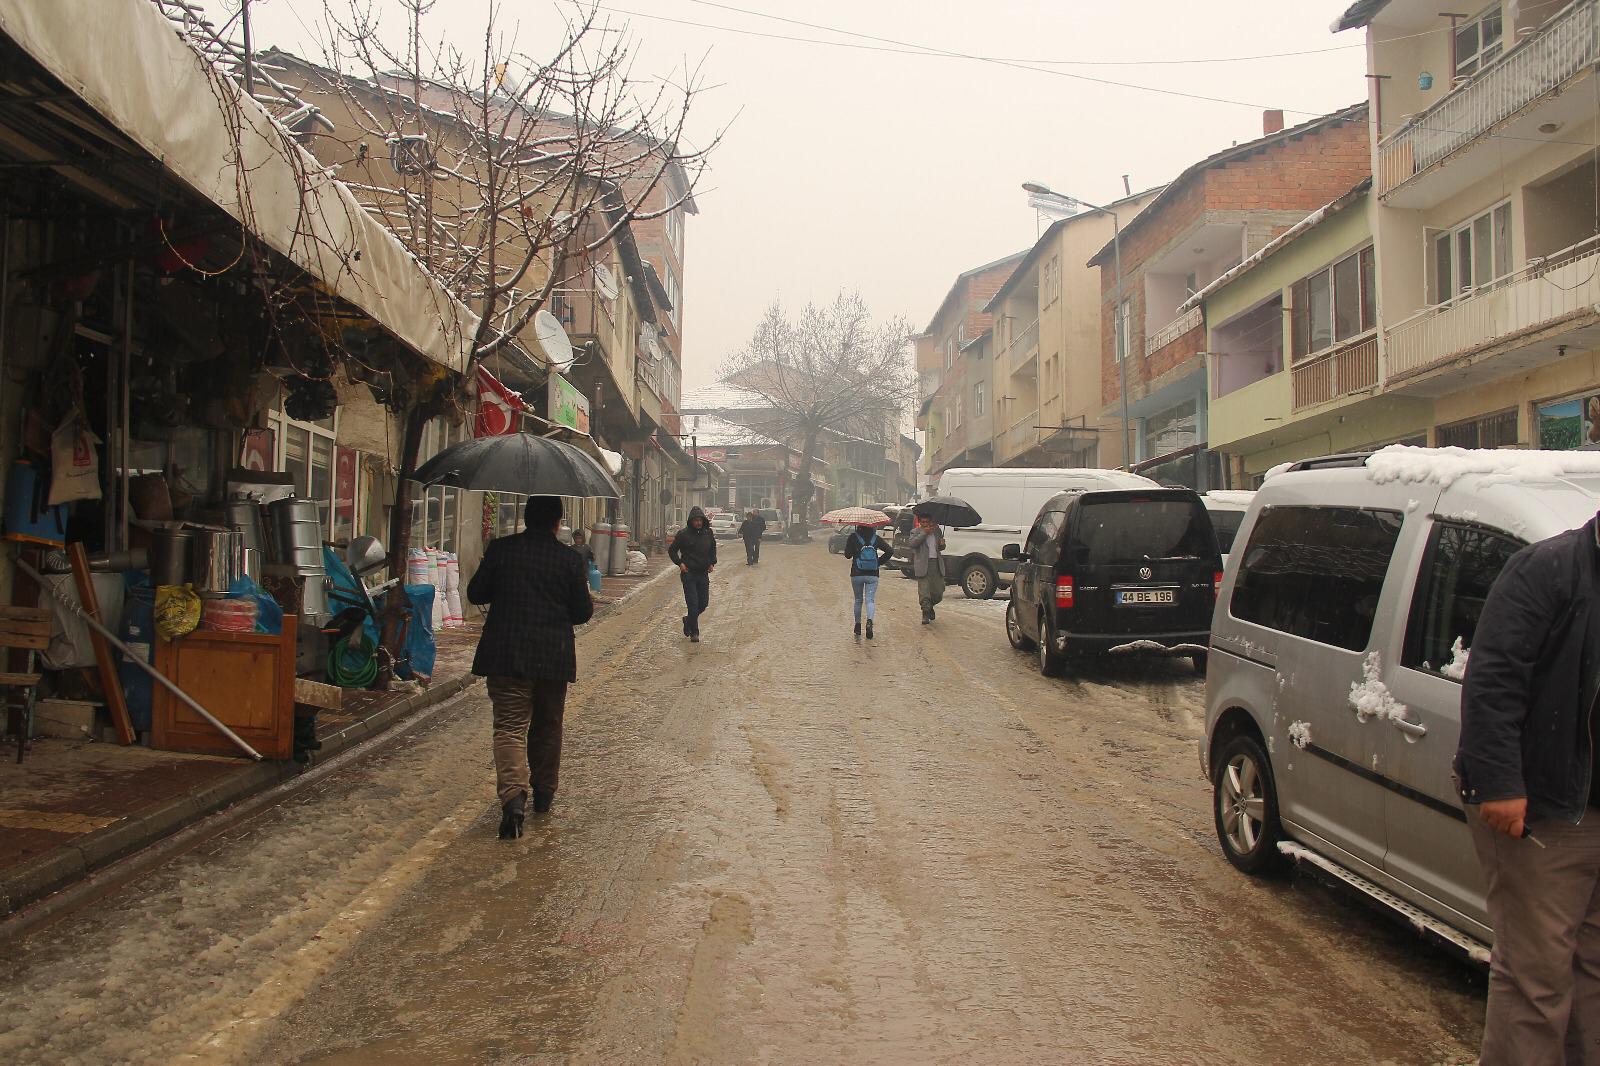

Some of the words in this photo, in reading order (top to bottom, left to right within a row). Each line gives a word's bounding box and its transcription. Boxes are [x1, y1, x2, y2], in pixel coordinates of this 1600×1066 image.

[1122, 592, 1134, 602] 44
[1137, 592, 1151, 602] BE
[1154, 591, 1172, 602] 196
